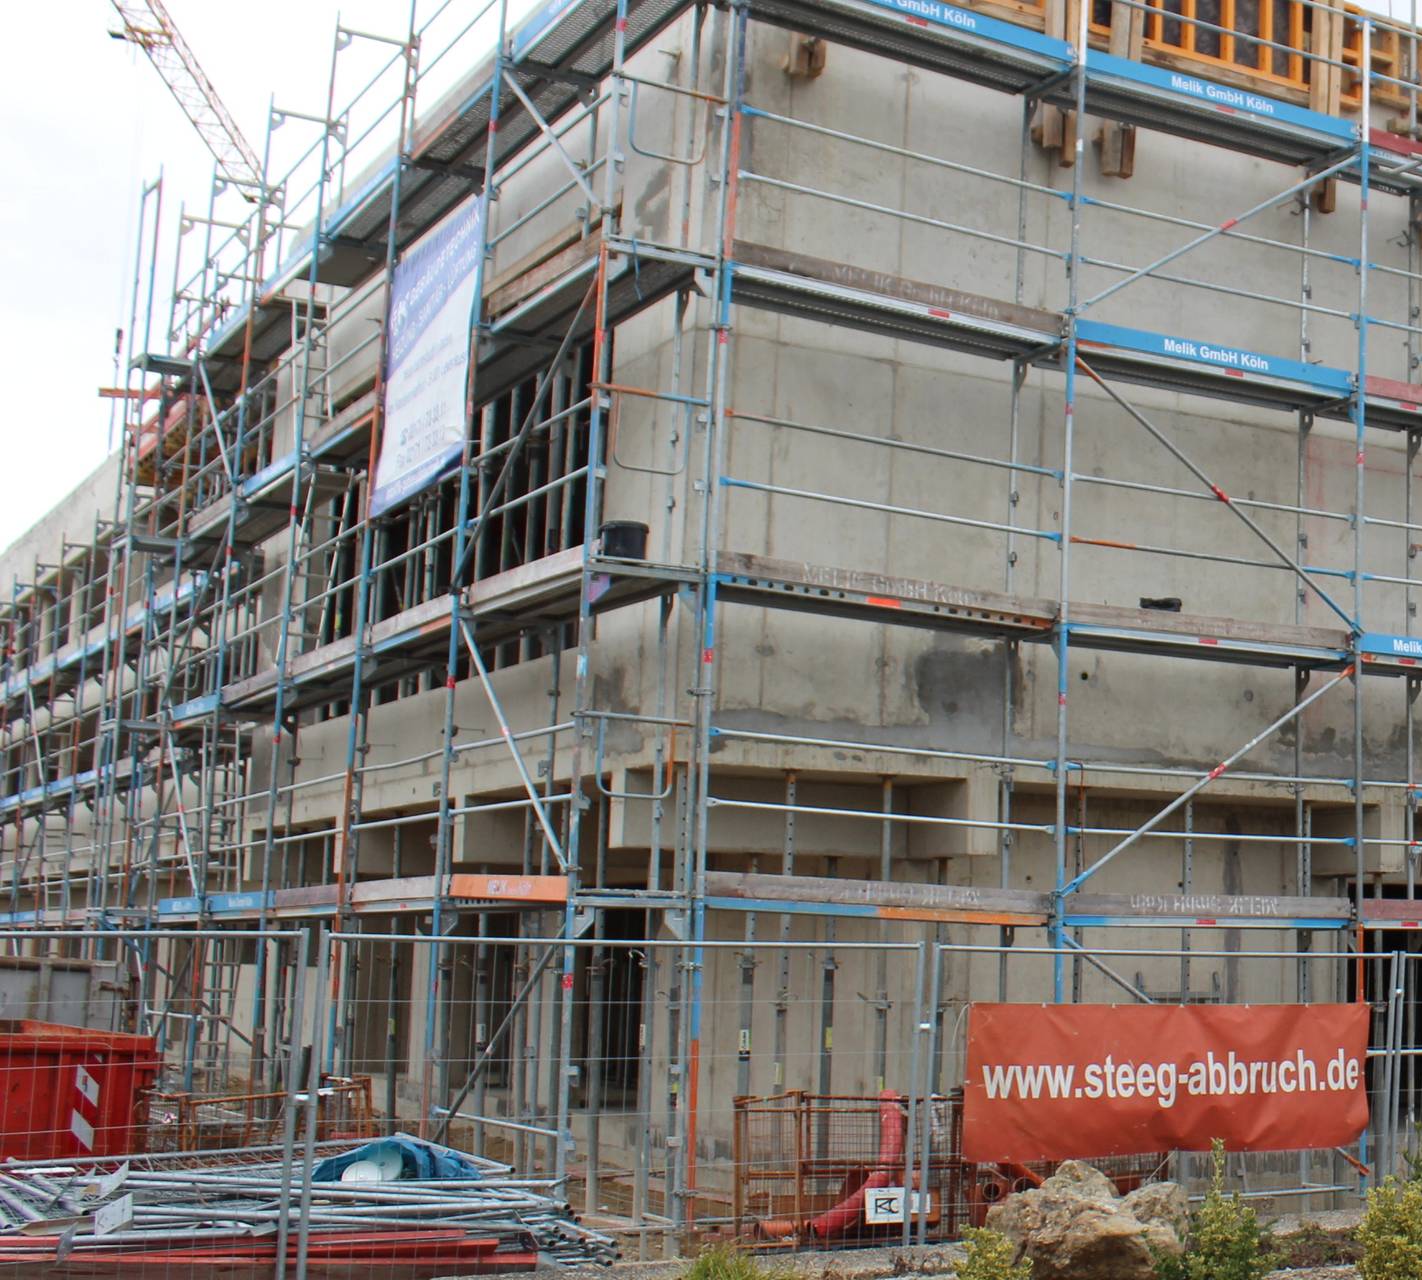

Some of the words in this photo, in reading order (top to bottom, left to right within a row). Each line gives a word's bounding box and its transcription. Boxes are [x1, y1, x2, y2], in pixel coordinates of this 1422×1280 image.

[897, 0, 940, 17] GmbH
[943, 8, 976, 28] Köln
[1171, 75, 1203, 94] Melik
[1206, 85, 1243, 104] GmbH
[1246, 95, 1274, 113] Köln
[1163, 338, 1197, 357] Melik
[1199, 346, 1238, 364] GmbH
[1240, 353, 1268, 371] Köln
[1393, 639, 1422, 654] Melik
[982, 1048, 1359, 1108] www.steeg-abbruch.de
